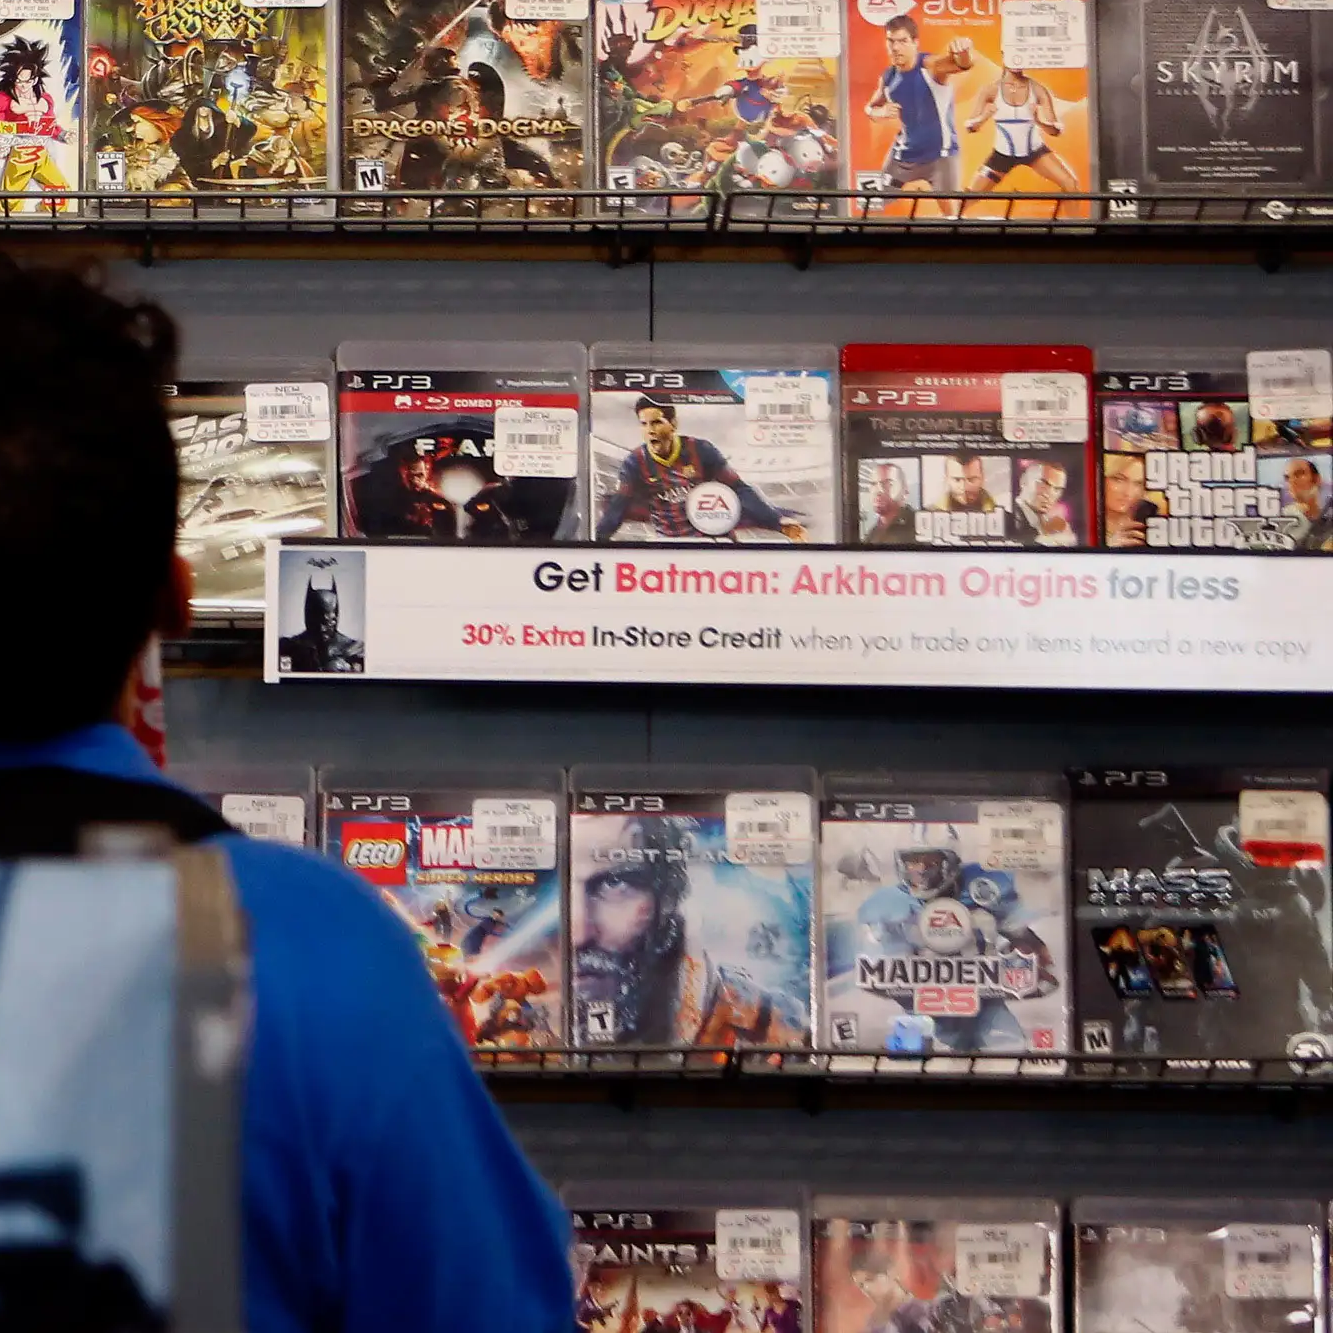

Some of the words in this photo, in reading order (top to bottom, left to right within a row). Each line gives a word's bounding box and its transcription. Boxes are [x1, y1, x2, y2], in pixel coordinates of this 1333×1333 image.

[1156, 60, 1300, 84] SKYRIM
[473, 118, 567, 139] DOGMA
[454, 399, 493, 408] COMBO
[496, 399, 524, 409] PACK
[1167, 483, 1281, 518] theft
[533, 561, 604, 593] Get
[615, 562, 780, 594] Batman:
[791, 564, 946, 596] Arkham
[960, 566, 1098, 607] Origins
[1107, 567, 1159, 601] for
[1168, 570, 1241, 601] less
[462, 624, 516, 646] 30%
[521, 625, 585, 647] Extra
[592, 625, 693, 649] In-Store
[699, 626, 782, 649] Credit
[790, 627, 852, 651] when
[858, 635, 902, 660] you
[910, 628, 969, 653] trade
[976, 635, 1018, 662] any
[1024, 632, 1083, 655] items
[1089, 631, 1171, 656] toward
[1177, 639, 1193, 656] a
[1199, 639, 1246, 657] new
[1253, 639, 1313, 665] copy
[343, 838, 407, 868] LEGO
[1087, 867, 1232, 895] MASS
[856, 957, 1003, 987] MADDEN
[916, 987, 978, 1016] 25
